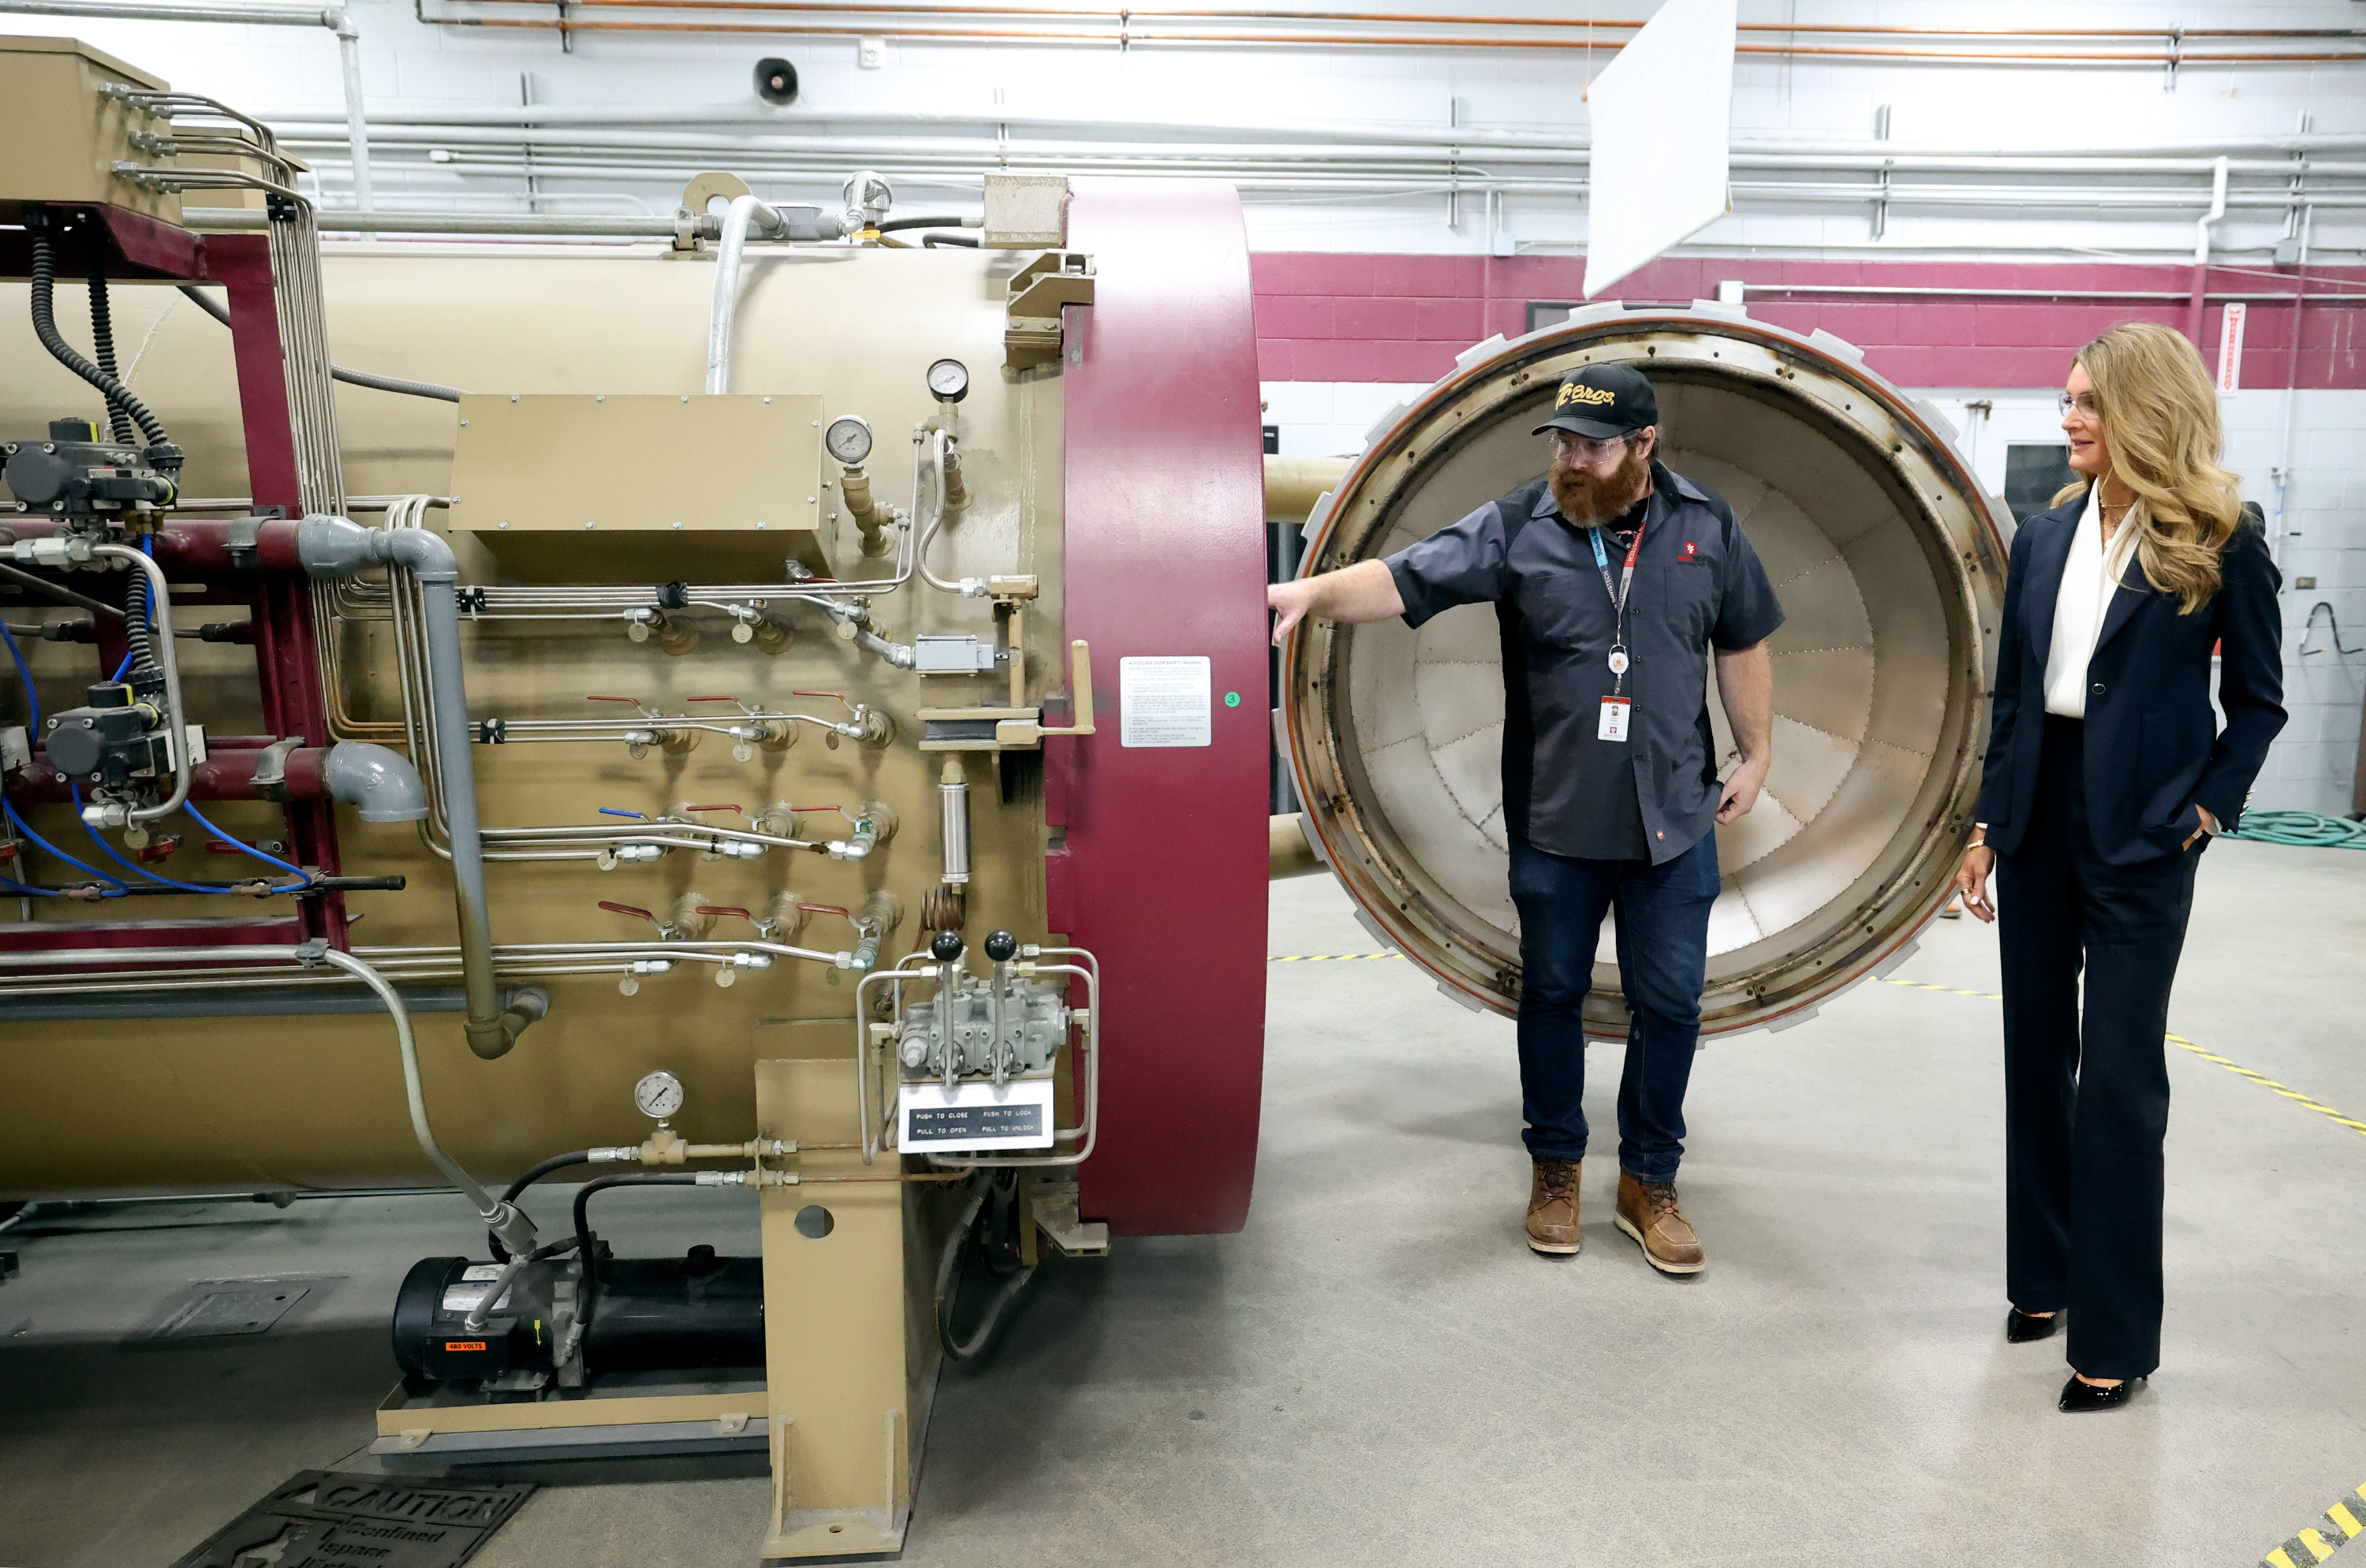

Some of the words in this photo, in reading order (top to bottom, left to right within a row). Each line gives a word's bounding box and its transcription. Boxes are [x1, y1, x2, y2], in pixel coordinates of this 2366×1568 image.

[1555, 383, 1573, 410] TC
[1603, 570, 1616, 603] DAVISTECH
[1228, 695, 1235, 704] 3
[324, 1486, 508, 1519] CAUTION
[346, 1522, 446, 1543] Confined
[323, 1542, 391, 1557] space
